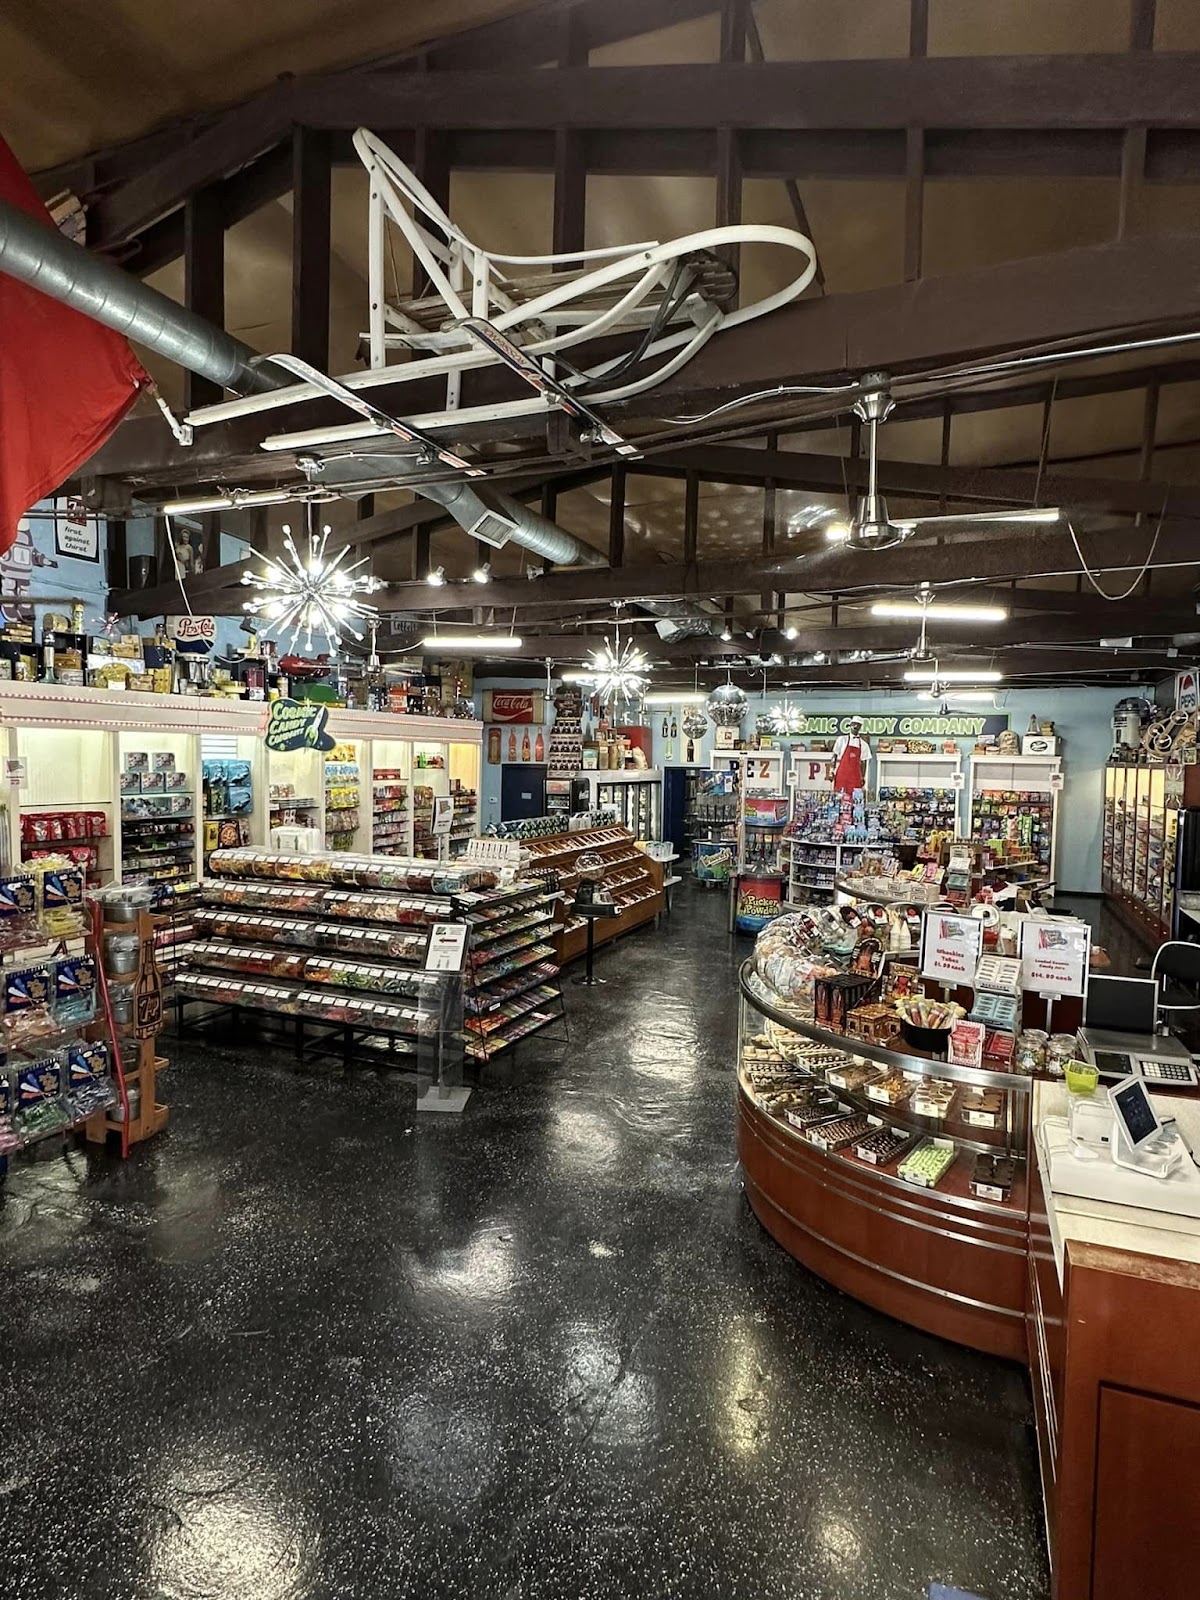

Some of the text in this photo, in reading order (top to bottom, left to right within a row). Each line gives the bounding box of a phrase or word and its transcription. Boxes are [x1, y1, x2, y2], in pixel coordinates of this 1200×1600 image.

[64, 526, 82, 535] first
[64, 534, 91, 545] against
[65, 543, 87, 552] thirst
[269, 718, 307, 735] CANDY
[840, 717, 897, 734] CNDY
[899, 717, 986, 735] COMPANY
[747, 895, 779, 906] Pucker
